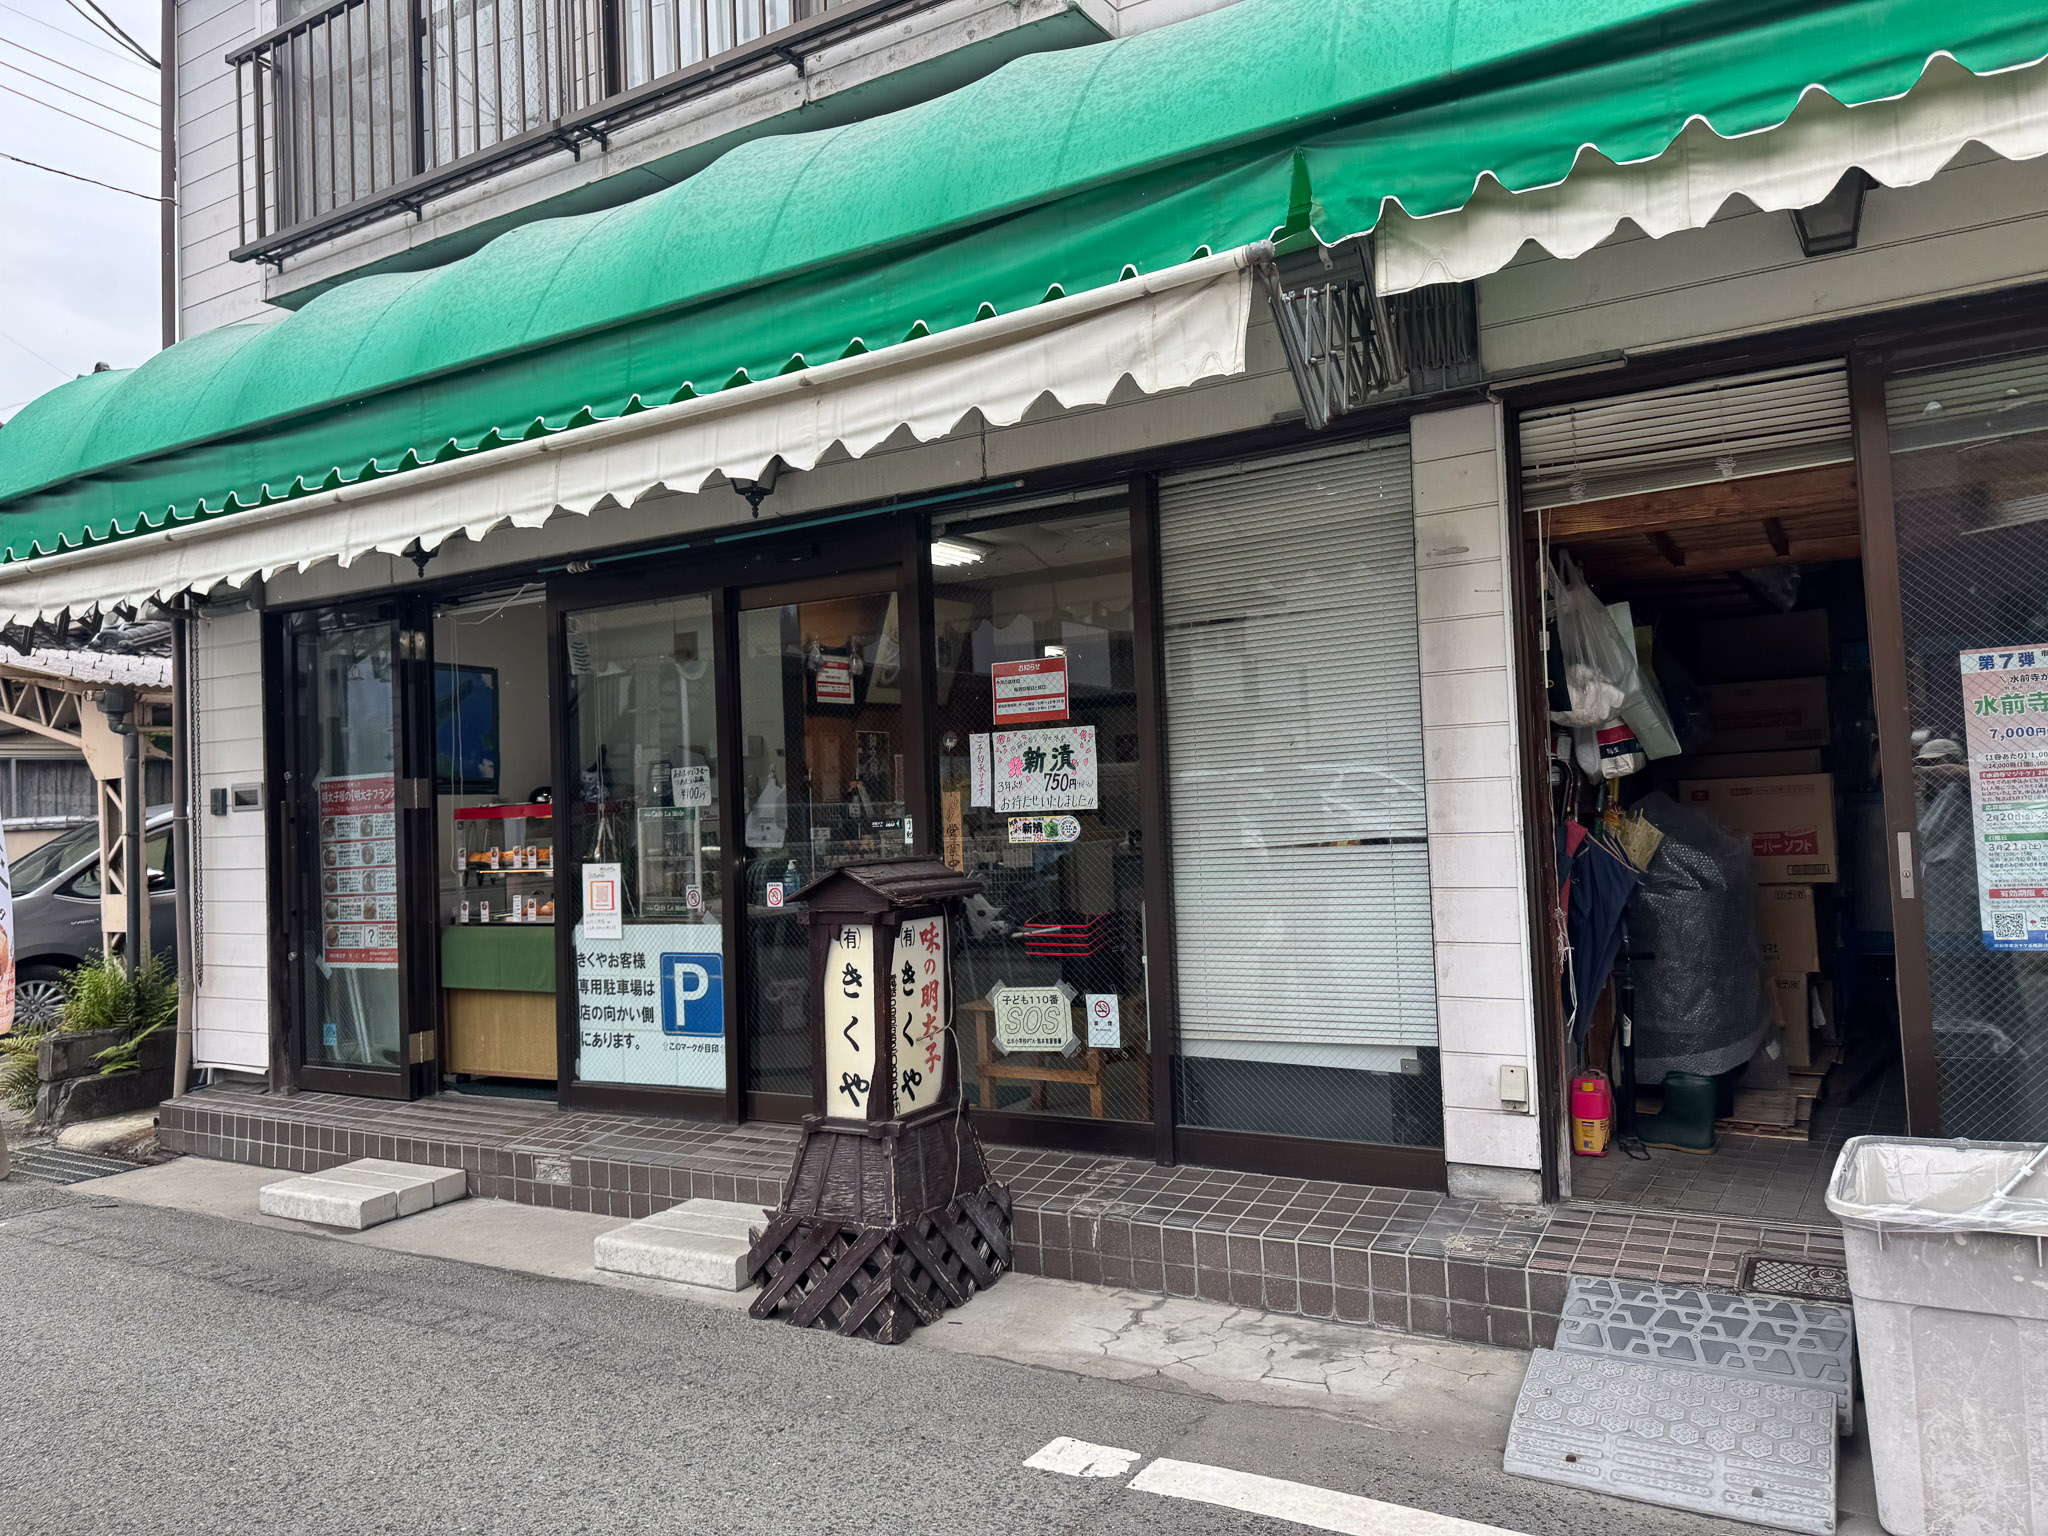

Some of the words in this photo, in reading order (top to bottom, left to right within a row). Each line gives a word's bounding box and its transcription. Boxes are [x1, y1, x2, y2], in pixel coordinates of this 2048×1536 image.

[1017, 663, 1040, 672] お知らせ
[1978, 652, 2035, 670] 第7弾
[1989, 726, 2048, 741] 7,000円
[1022, 743, 1076, 774] 新漬
[1754, 839, 1813, 852] ーパーソフト
[577, 952, 646, 969] きくやお客様
[579, 978, 655, 996] 専用駐車場は
[674, 963, 709, 1026] P
[919, 921, 941, 1074] 味の明太子
[1002, 995, 1059, 1005] 子ども110番
[580, 1005, 654, 1023] 店の向かい側
[1005, 1006, 1061, 1034] SOS
[581, 1031, 640, 1050] にあります。
[669, 1042, 719, 1053] このマークが目印
